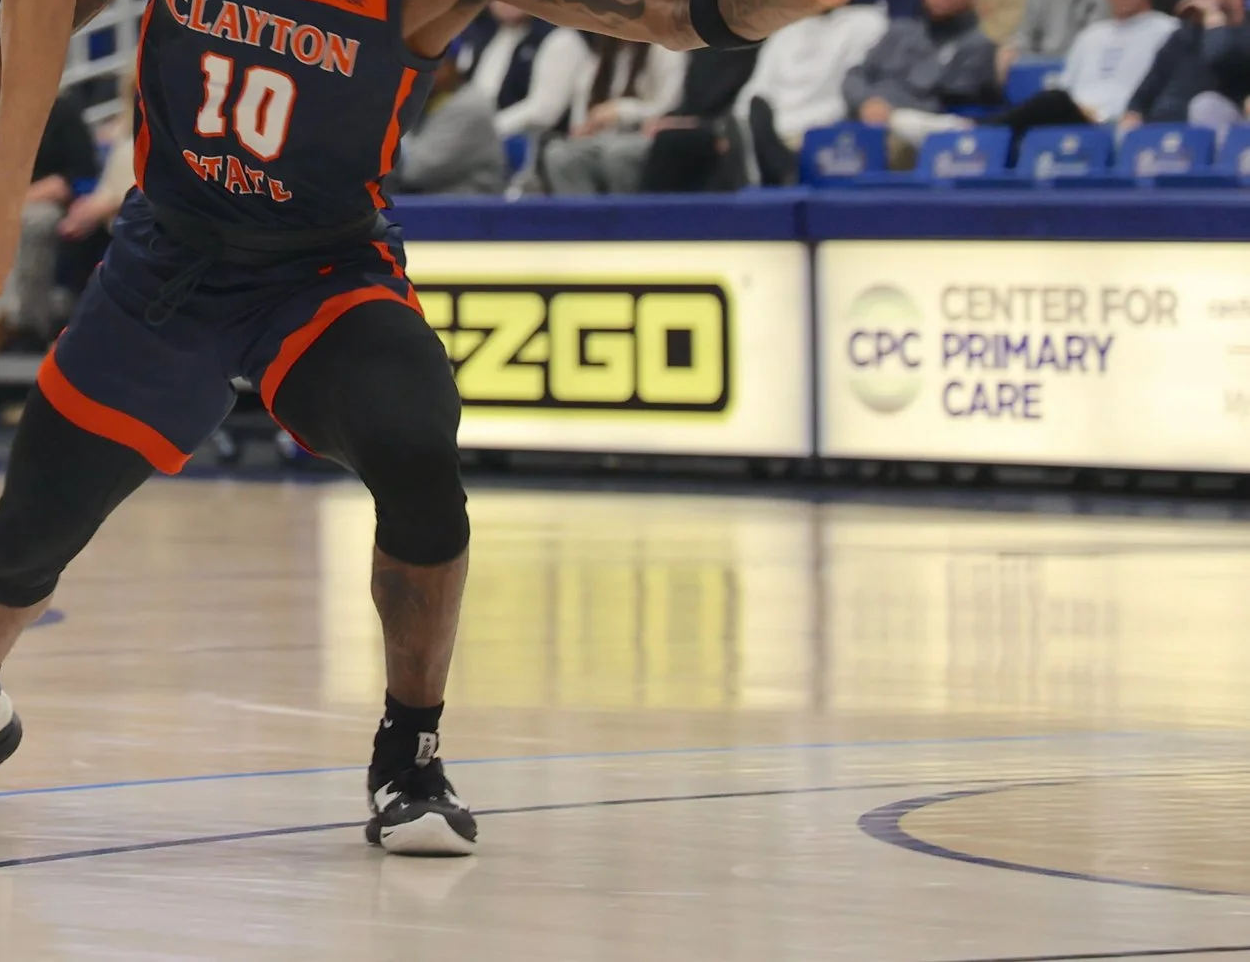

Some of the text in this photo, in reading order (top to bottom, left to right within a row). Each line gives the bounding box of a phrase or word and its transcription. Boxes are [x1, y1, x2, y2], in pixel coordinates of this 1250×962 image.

[194, 50, 298, 162] 10
[940, 284, 1088, 323] CENTER
[1101, 286, 1178, 326] FOR
[848, 330, 921, 368] CPC
[941, 332, 1114, 373] PRIMARY
[942, 380, 1043, 419] CARE
